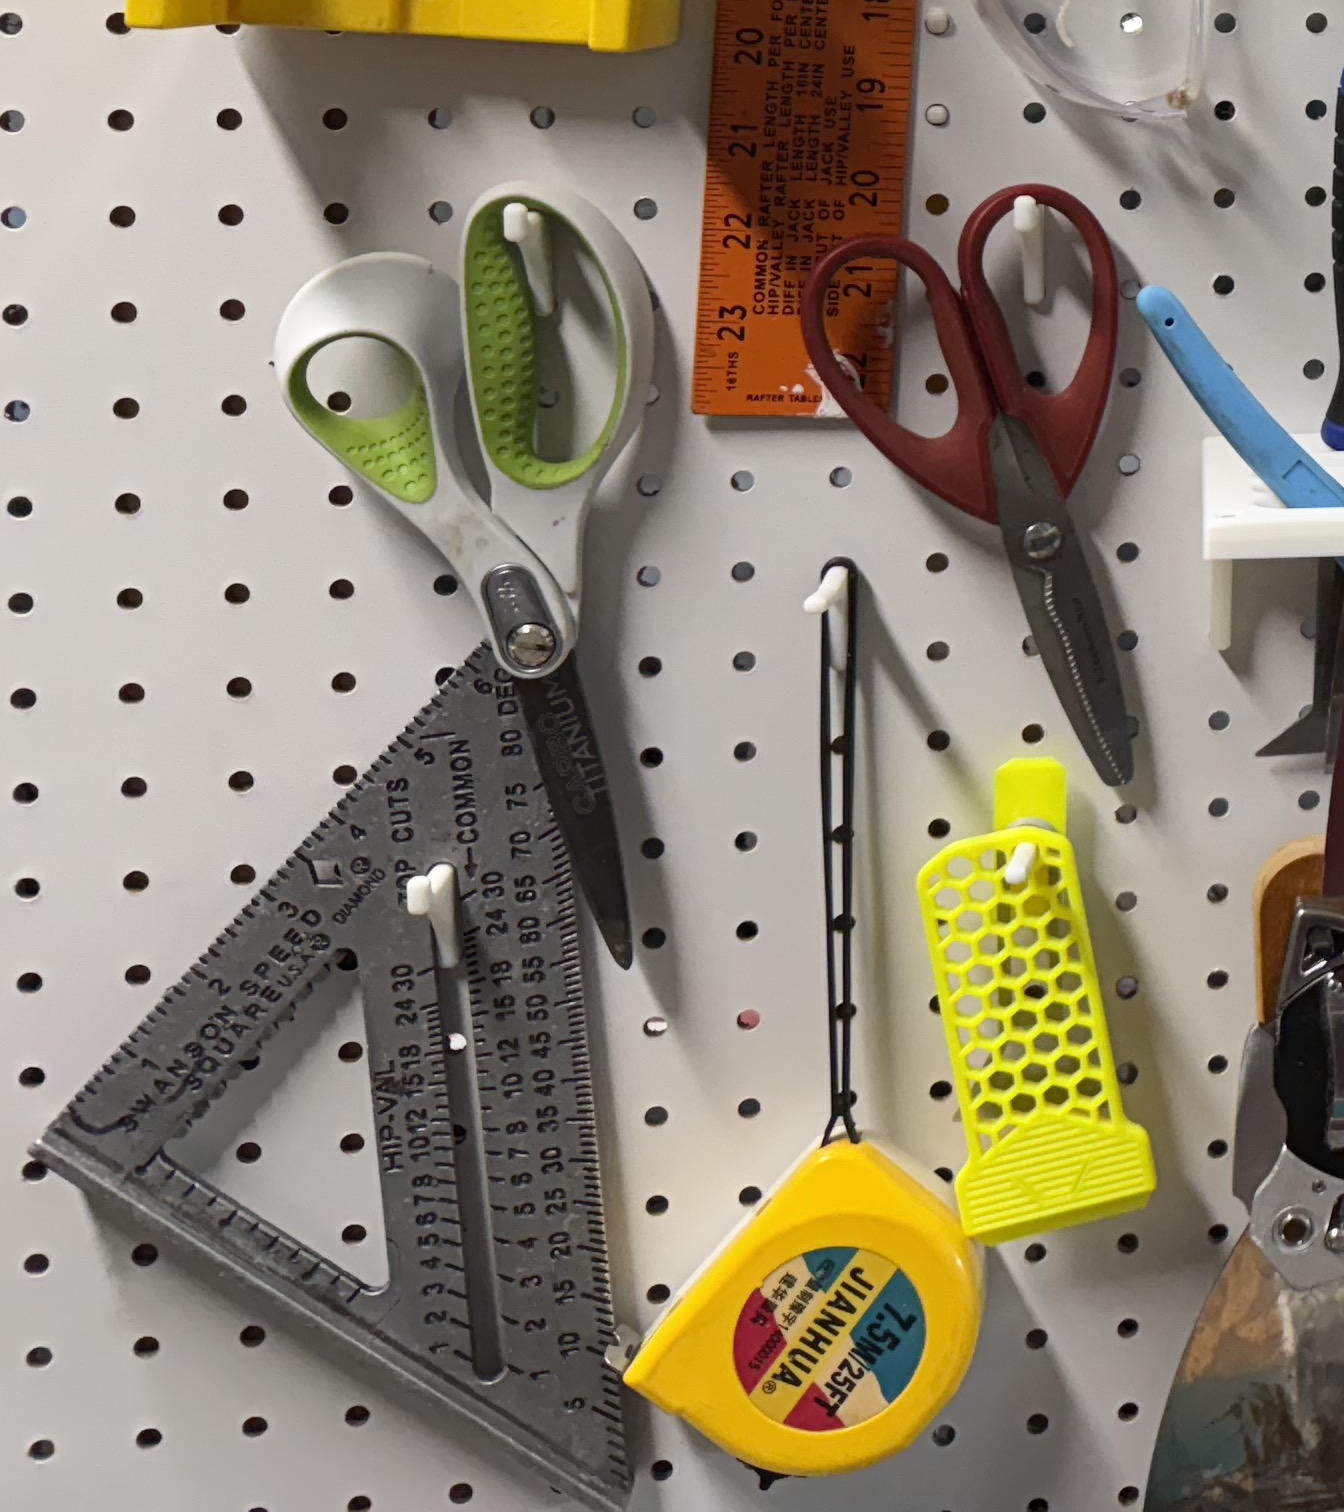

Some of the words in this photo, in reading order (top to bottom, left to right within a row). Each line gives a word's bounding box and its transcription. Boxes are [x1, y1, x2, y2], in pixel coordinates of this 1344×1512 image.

[734, 27, 765, 66] 20
[784, 14, 798, 47] PER
[768, 35, 781, 67] PER
[842, 45, 856, 78] USE
[779, 61, 795, 128] LENGTH
[823, 96, 837, 129] USE
[855, 78, 886, 113] 19
[763, 81, 779, 148] LENGTH
[727, 124, 758, 158] 21
[790, 114, 806, 181] LENGTH
[806, 115, 821, 181] LENGTH
[836, 90, 853, 186] HIP/VALLEY
[774, 140, 790, 207] RAFTER
[821, 142, 834, 186] JACK
[758, 161, 774, 227] RAFTER
[848, 170, 880, 207] 20
[786, 199, 801, 242] JACK
[801, 199, 816, 243] JACK
[818, 199, 831, 221] OF
[833, 199, 846, 221] OF
[722, 213, 752, 249] 22
[753, 240, 769, 315] COMMON
[767, 218, 785, 315] HIP/VALLEY
[785, 255, 798, 271] IN
[782, 279, 796, 316] DIFF
[717, 305, 747, 342] 23
[500, 729, 524, 757] 80
[386, 777, 415, 844] CUTS
[448, 739, 480, 845] COMMON
[506, 782, 529, 811] 75
[509, 831, 534, 860] 70
[331, 868, 387, 925] DIAMOND
[521, 955, 545, 984] 55
[544, 1188, 568, 1216] 25
[771, 1267, 875, 1387] JIANHUA
